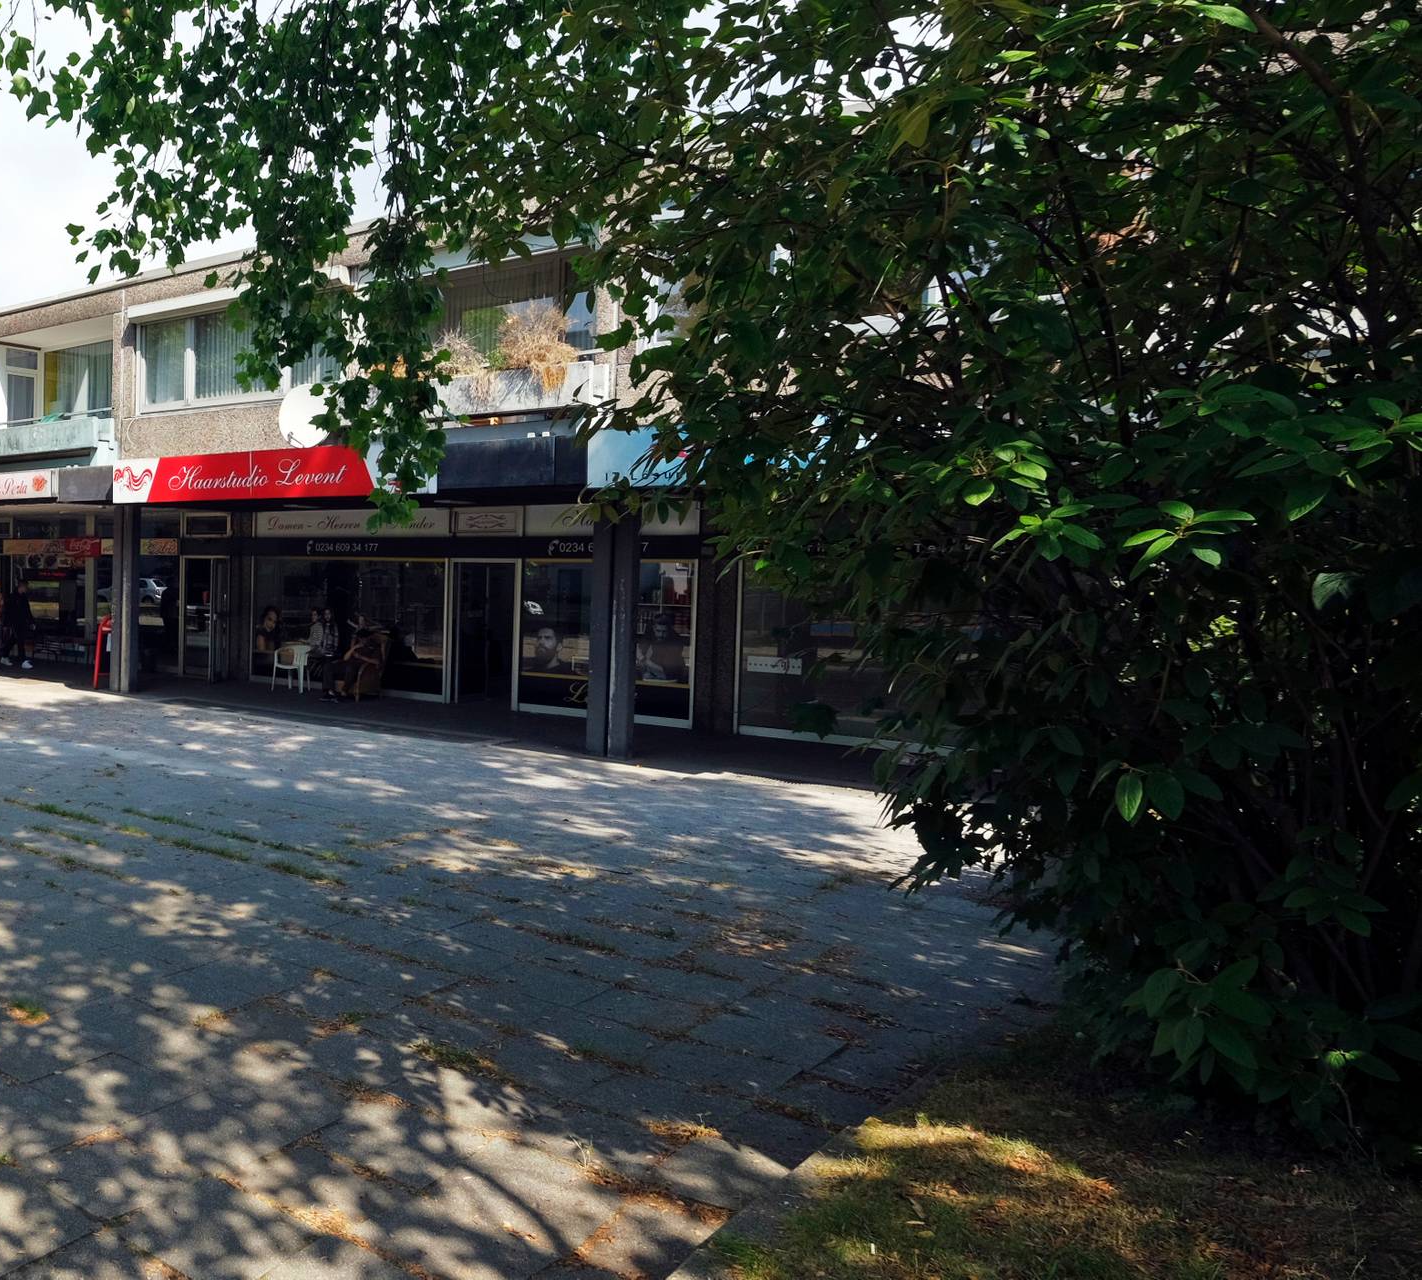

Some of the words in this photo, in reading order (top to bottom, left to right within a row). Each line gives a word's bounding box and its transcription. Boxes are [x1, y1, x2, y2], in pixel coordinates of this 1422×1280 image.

[168, 464, 268, 491] Haarstudio
[275, 457, 347, 487] Levent
[2, 477, 28, 496] Perla
[267, 515, 304, 530] Damen
[317, 513, 361, 530] Herren
[315, 543, 334, 552] 0234
[335, 543, 351, 552] 609
[352, 543, 362, 552] 34
[364, 542, 379, 551] 177
[559, 542, 584, 552] 0234
